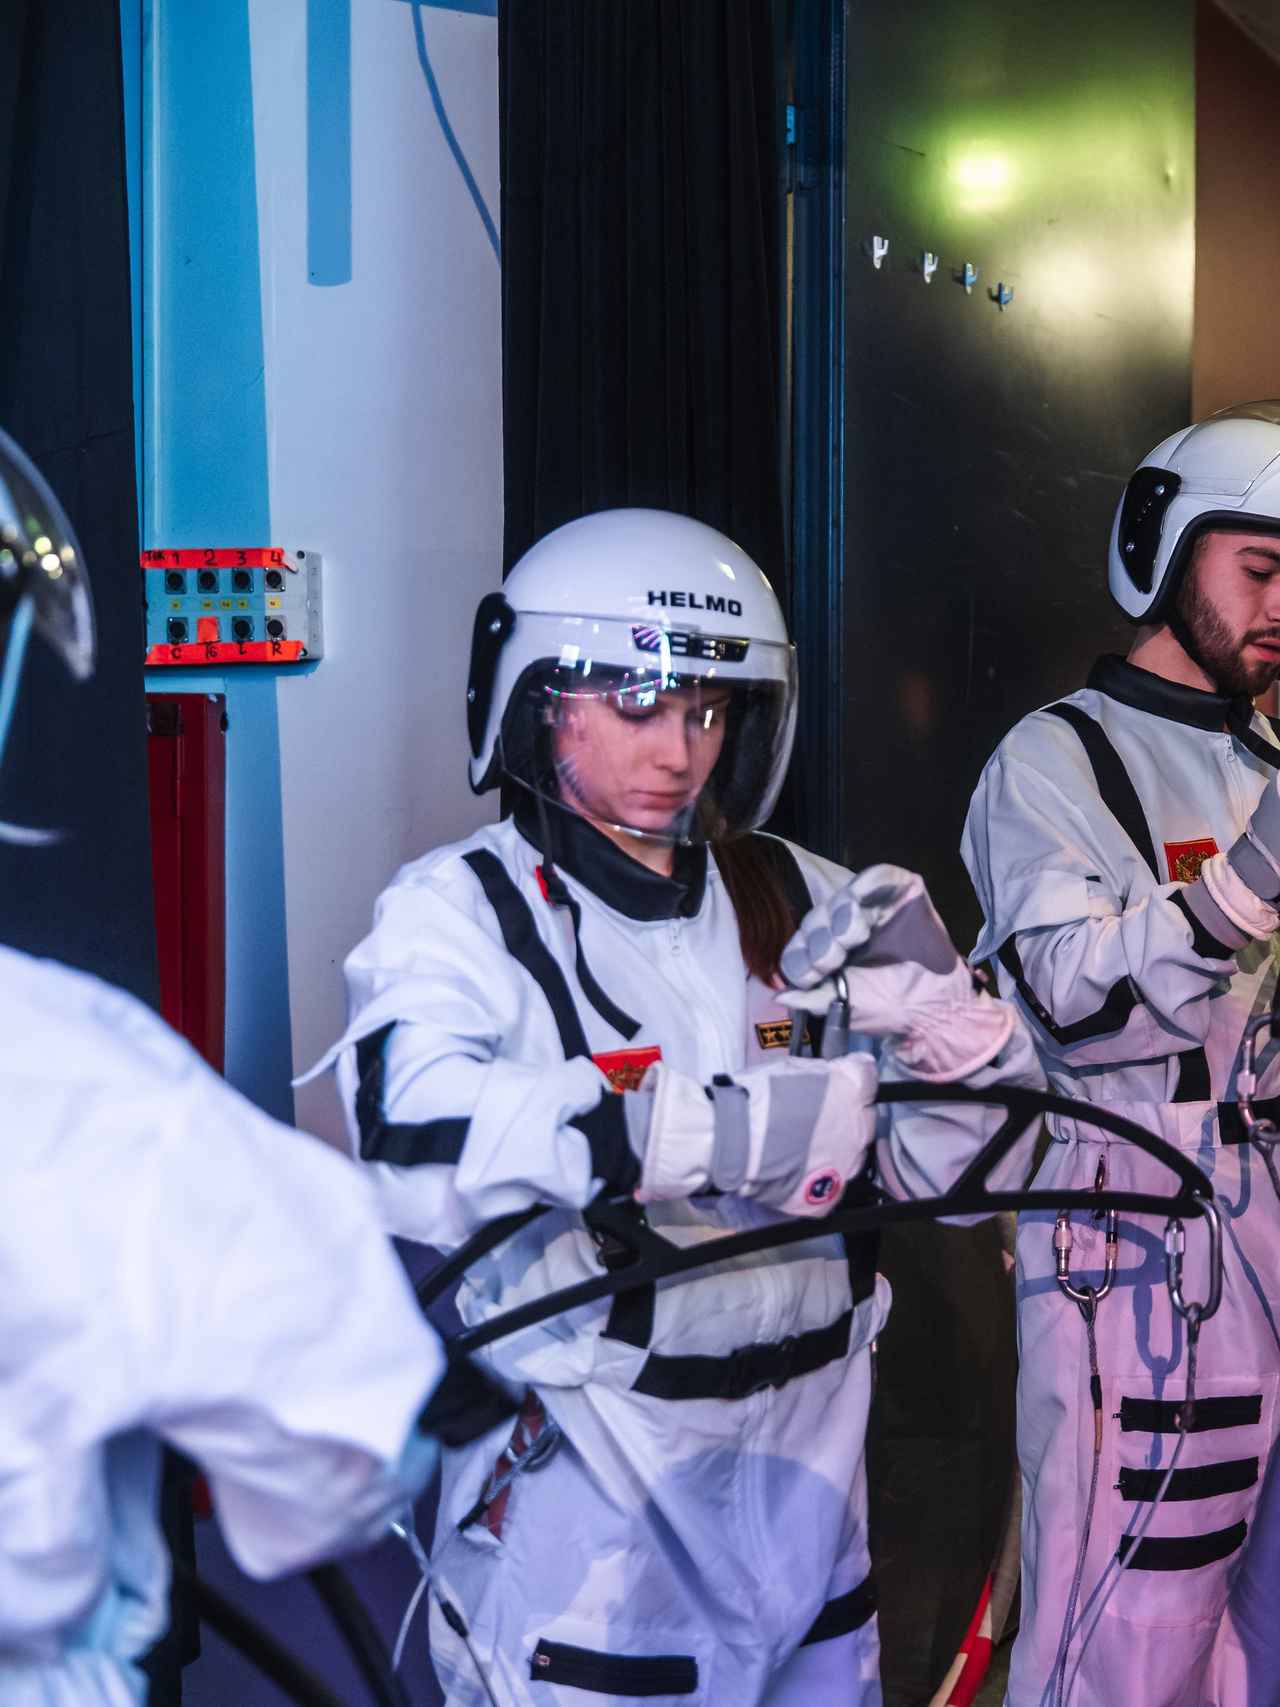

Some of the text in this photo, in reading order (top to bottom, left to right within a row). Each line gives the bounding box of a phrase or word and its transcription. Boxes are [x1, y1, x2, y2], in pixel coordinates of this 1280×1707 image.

[172, 551, 180, 564] 1
[204, 549, 217, 566] 2
[236, 550, 247, 566] 3
[270, 551, 281, 566] 4
[647, 590, 742, 616] HELMO
[271, 641, 281, 655] R
